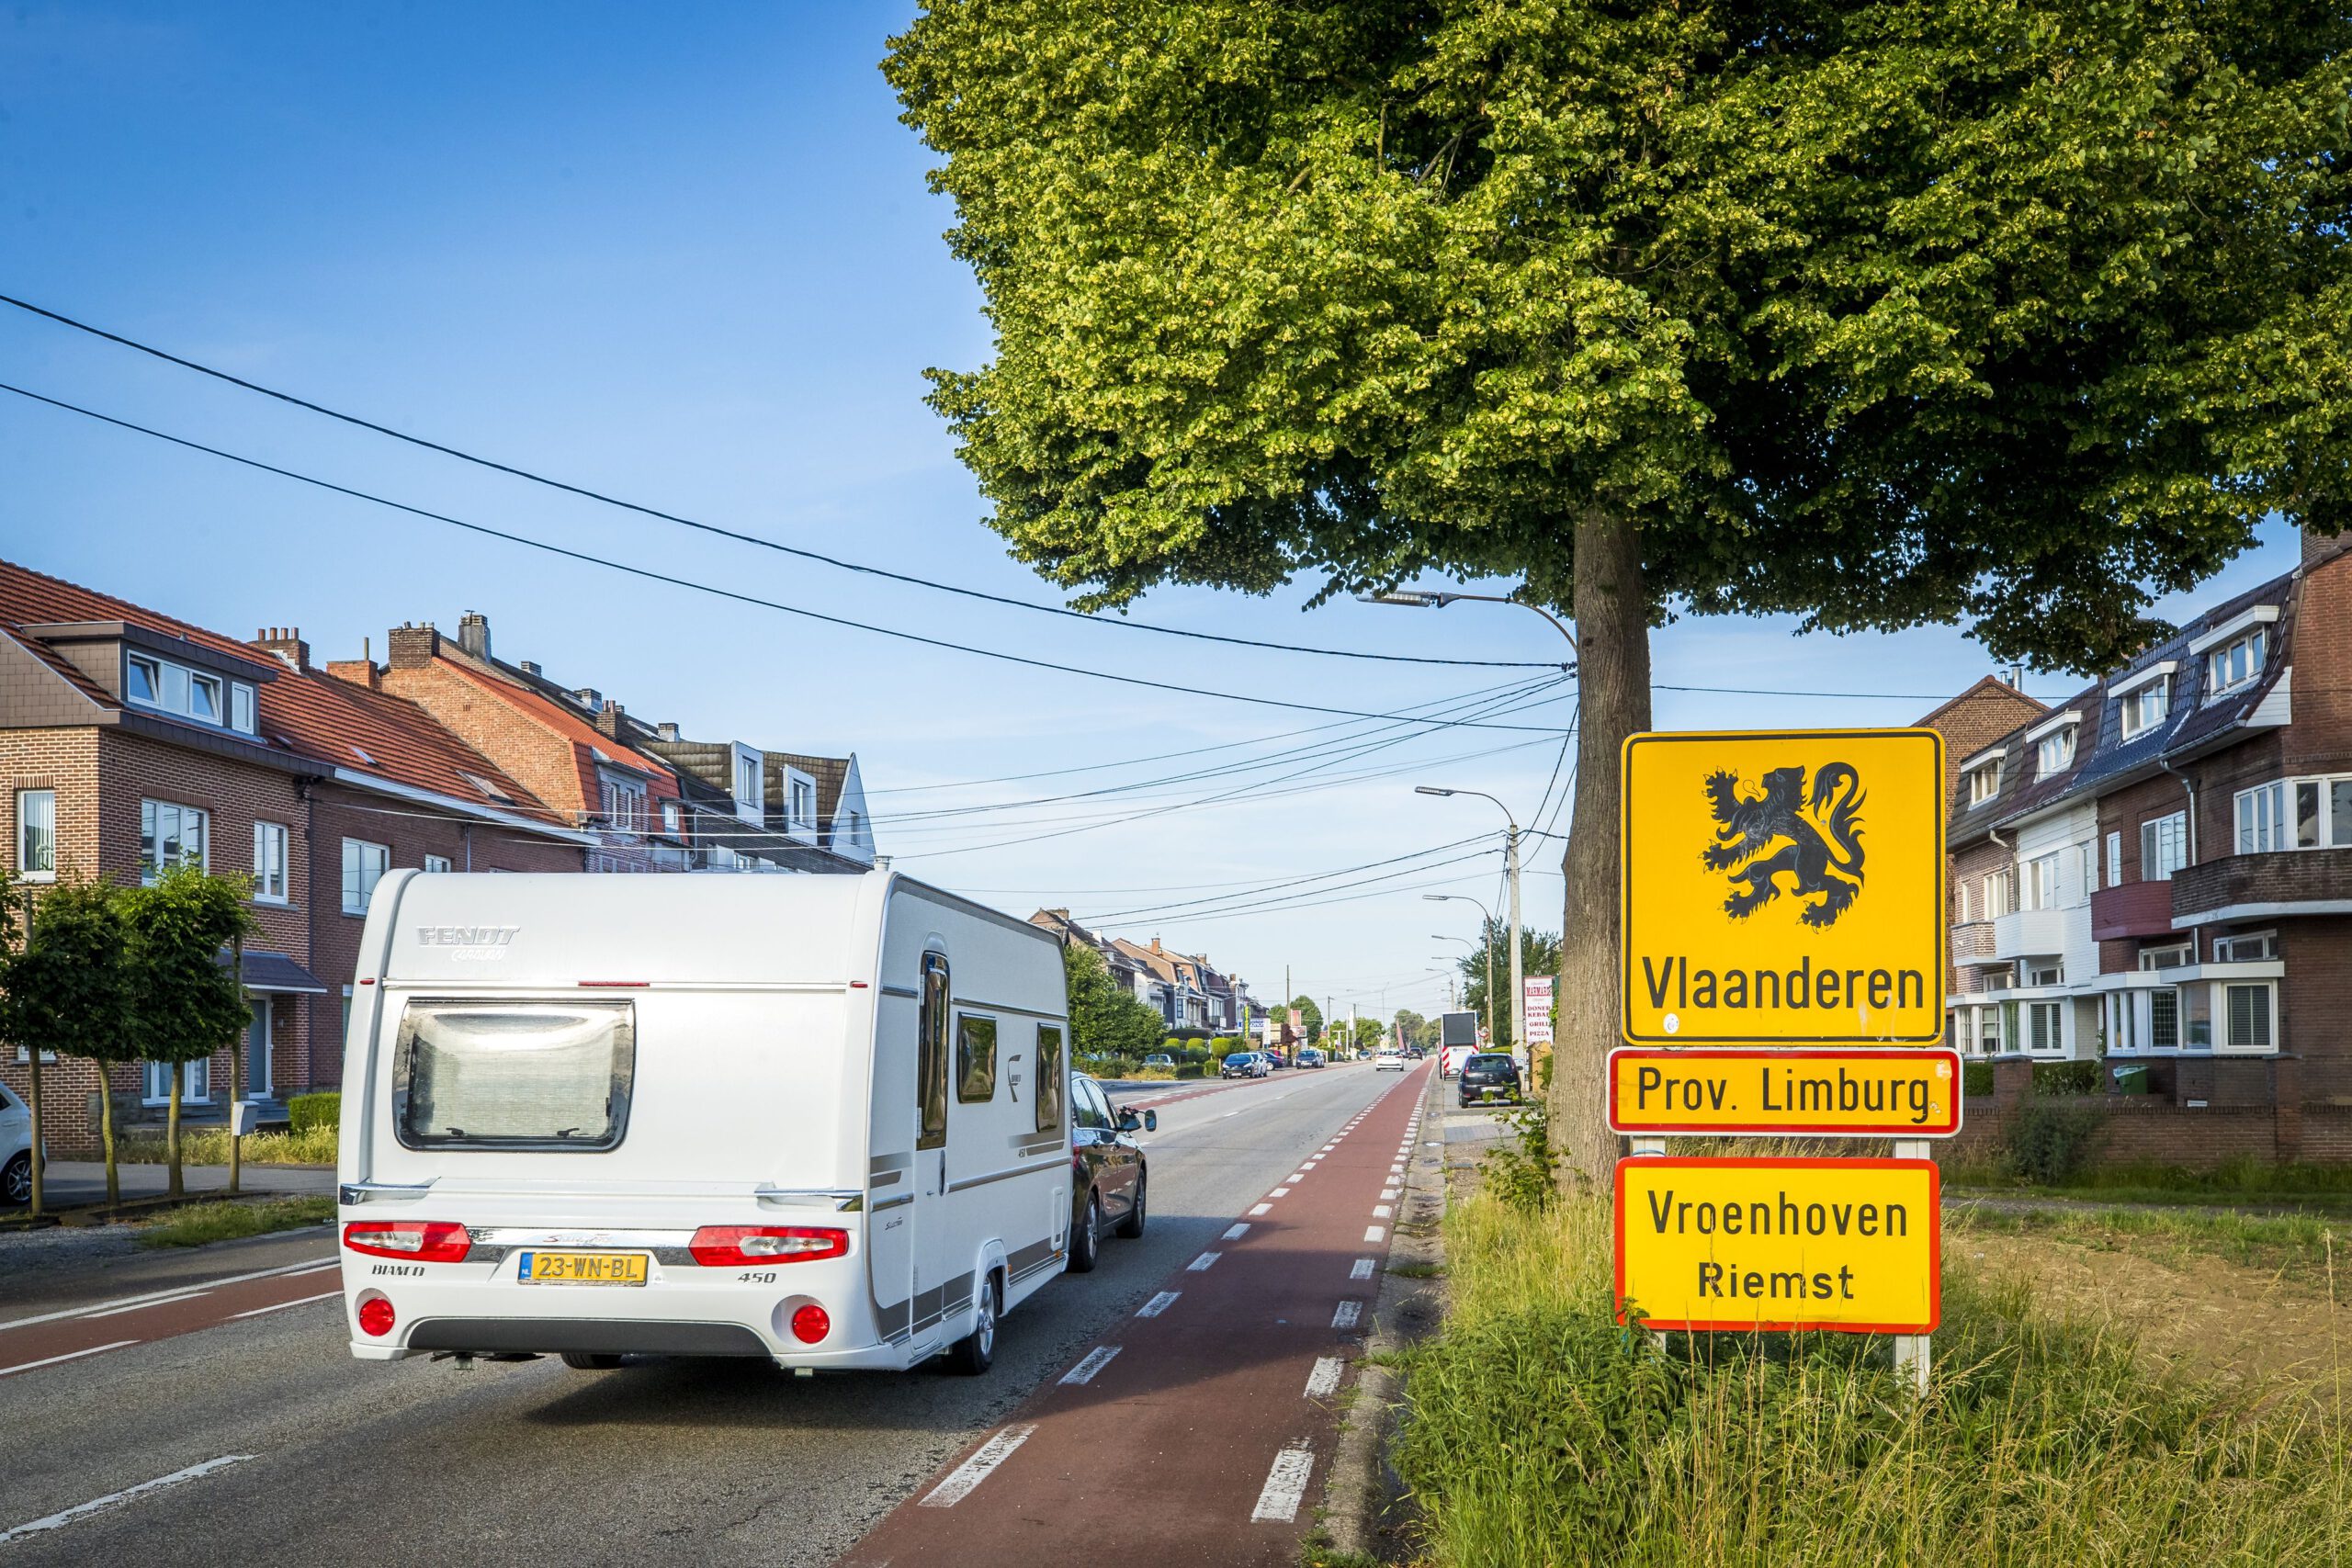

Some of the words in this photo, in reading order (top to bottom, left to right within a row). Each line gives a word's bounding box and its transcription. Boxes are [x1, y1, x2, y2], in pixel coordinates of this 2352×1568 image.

[416, 925, 520, 945] FENDT
[1642, 955, 1923, 1009] Vlaanderen
[1638, 1066, 1737, 1111] Prov.
[1763, 1067, 1929, 1123] Limburg
[1647, 1190, 1906, 1236] Vroenhoven
[372, 1264, 425, 1276] BIANCO
[538, 1257, 638, 1278] 23-WN-BL
[738, 1272, 776, 1283] 450
[1698, 1261, 1854, 1299] Riemst
